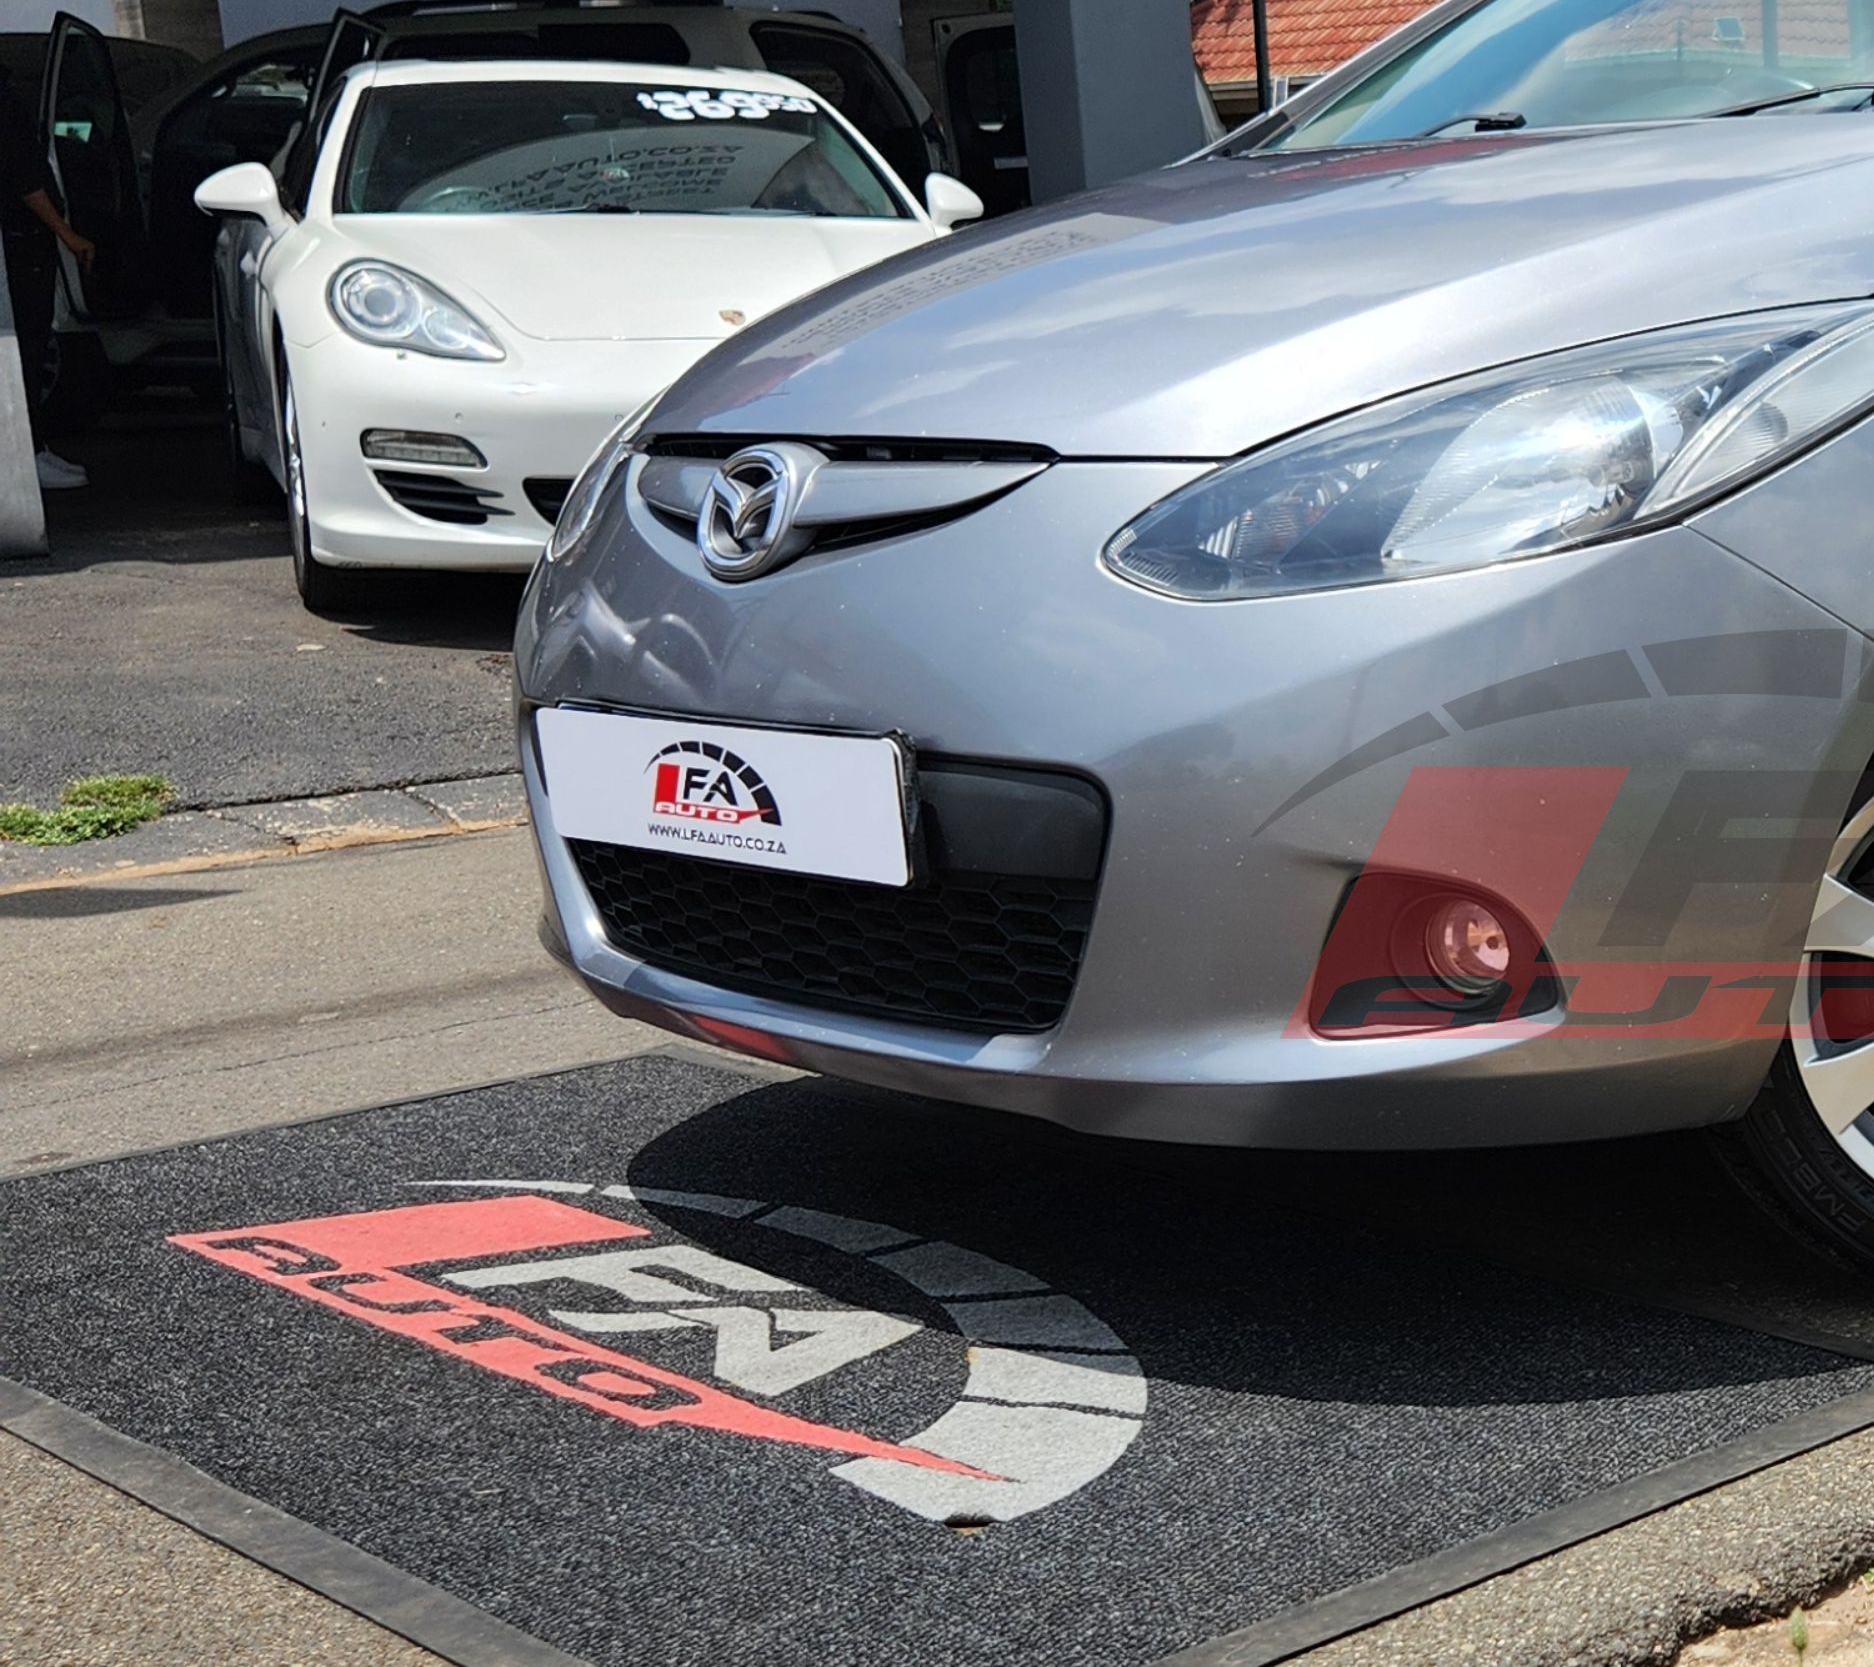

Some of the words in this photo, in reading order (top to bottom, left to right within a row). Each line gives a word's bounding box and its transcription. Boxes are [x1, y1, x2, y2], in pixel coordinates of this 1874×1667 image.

[655, 763, 739, 807] LFA
[655, 801, 739, 823] AUTO
[647, 822, 788, 855] WWW.LFAAUTO.CO.ZA
[202, 1237, 704, 1412] AUTO
